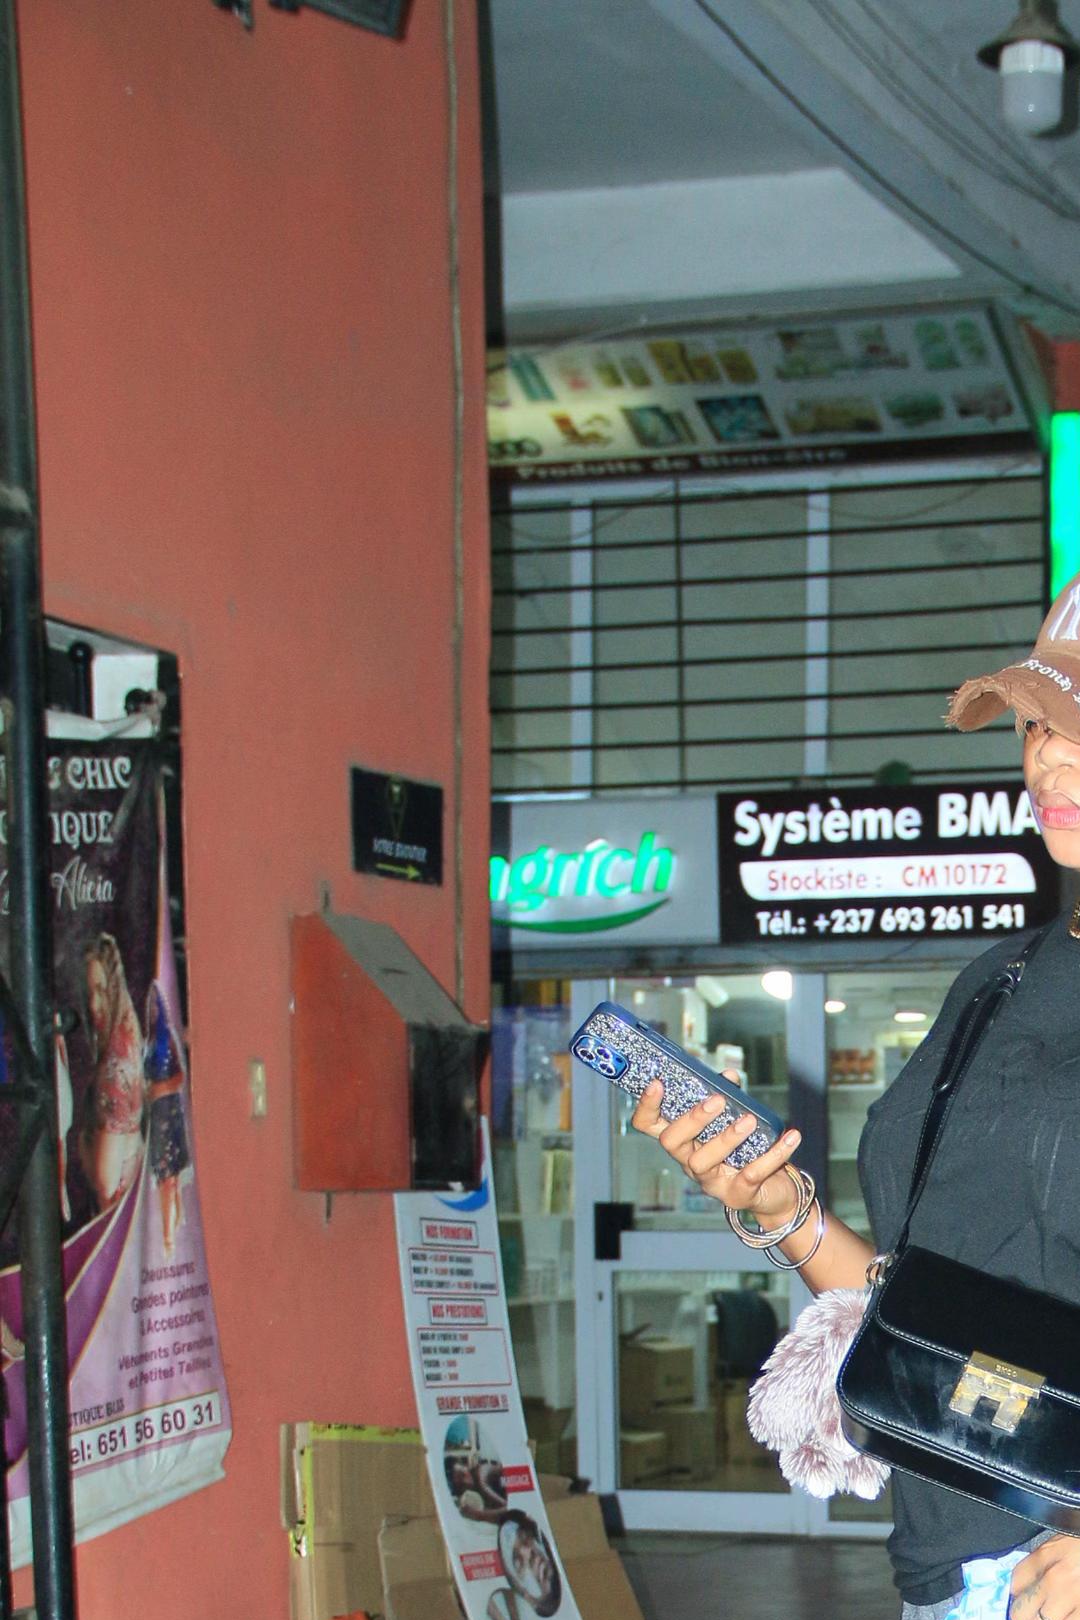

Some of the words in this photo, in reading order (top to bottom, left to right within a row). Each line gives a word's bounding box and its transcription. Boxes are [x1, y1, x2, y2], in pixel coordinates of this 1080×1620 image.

[67, 756, 132, 790] CHIC
[50, 810, 114, 850] IQUE
[734, 796, 922, 857] Système
[51, 856, 117, 911] Alicia
[768, 866, 869, 891] Stockiste
[755, 909, 807, 936] Tél.:
[813, 907, 875, 935] +237
[880, 906, 926, 933] 693
[931, 904, 974, 932] 261
[981, 903, 1025, 930] 541
[70, 1439, 92, 1465] el:
[98, 1424, 127, 1456] 651
[135, 1417, 154, 1443] 56
[161, 1409, 185, 1435] 60
[193, 1401, 215, 1426] 31
